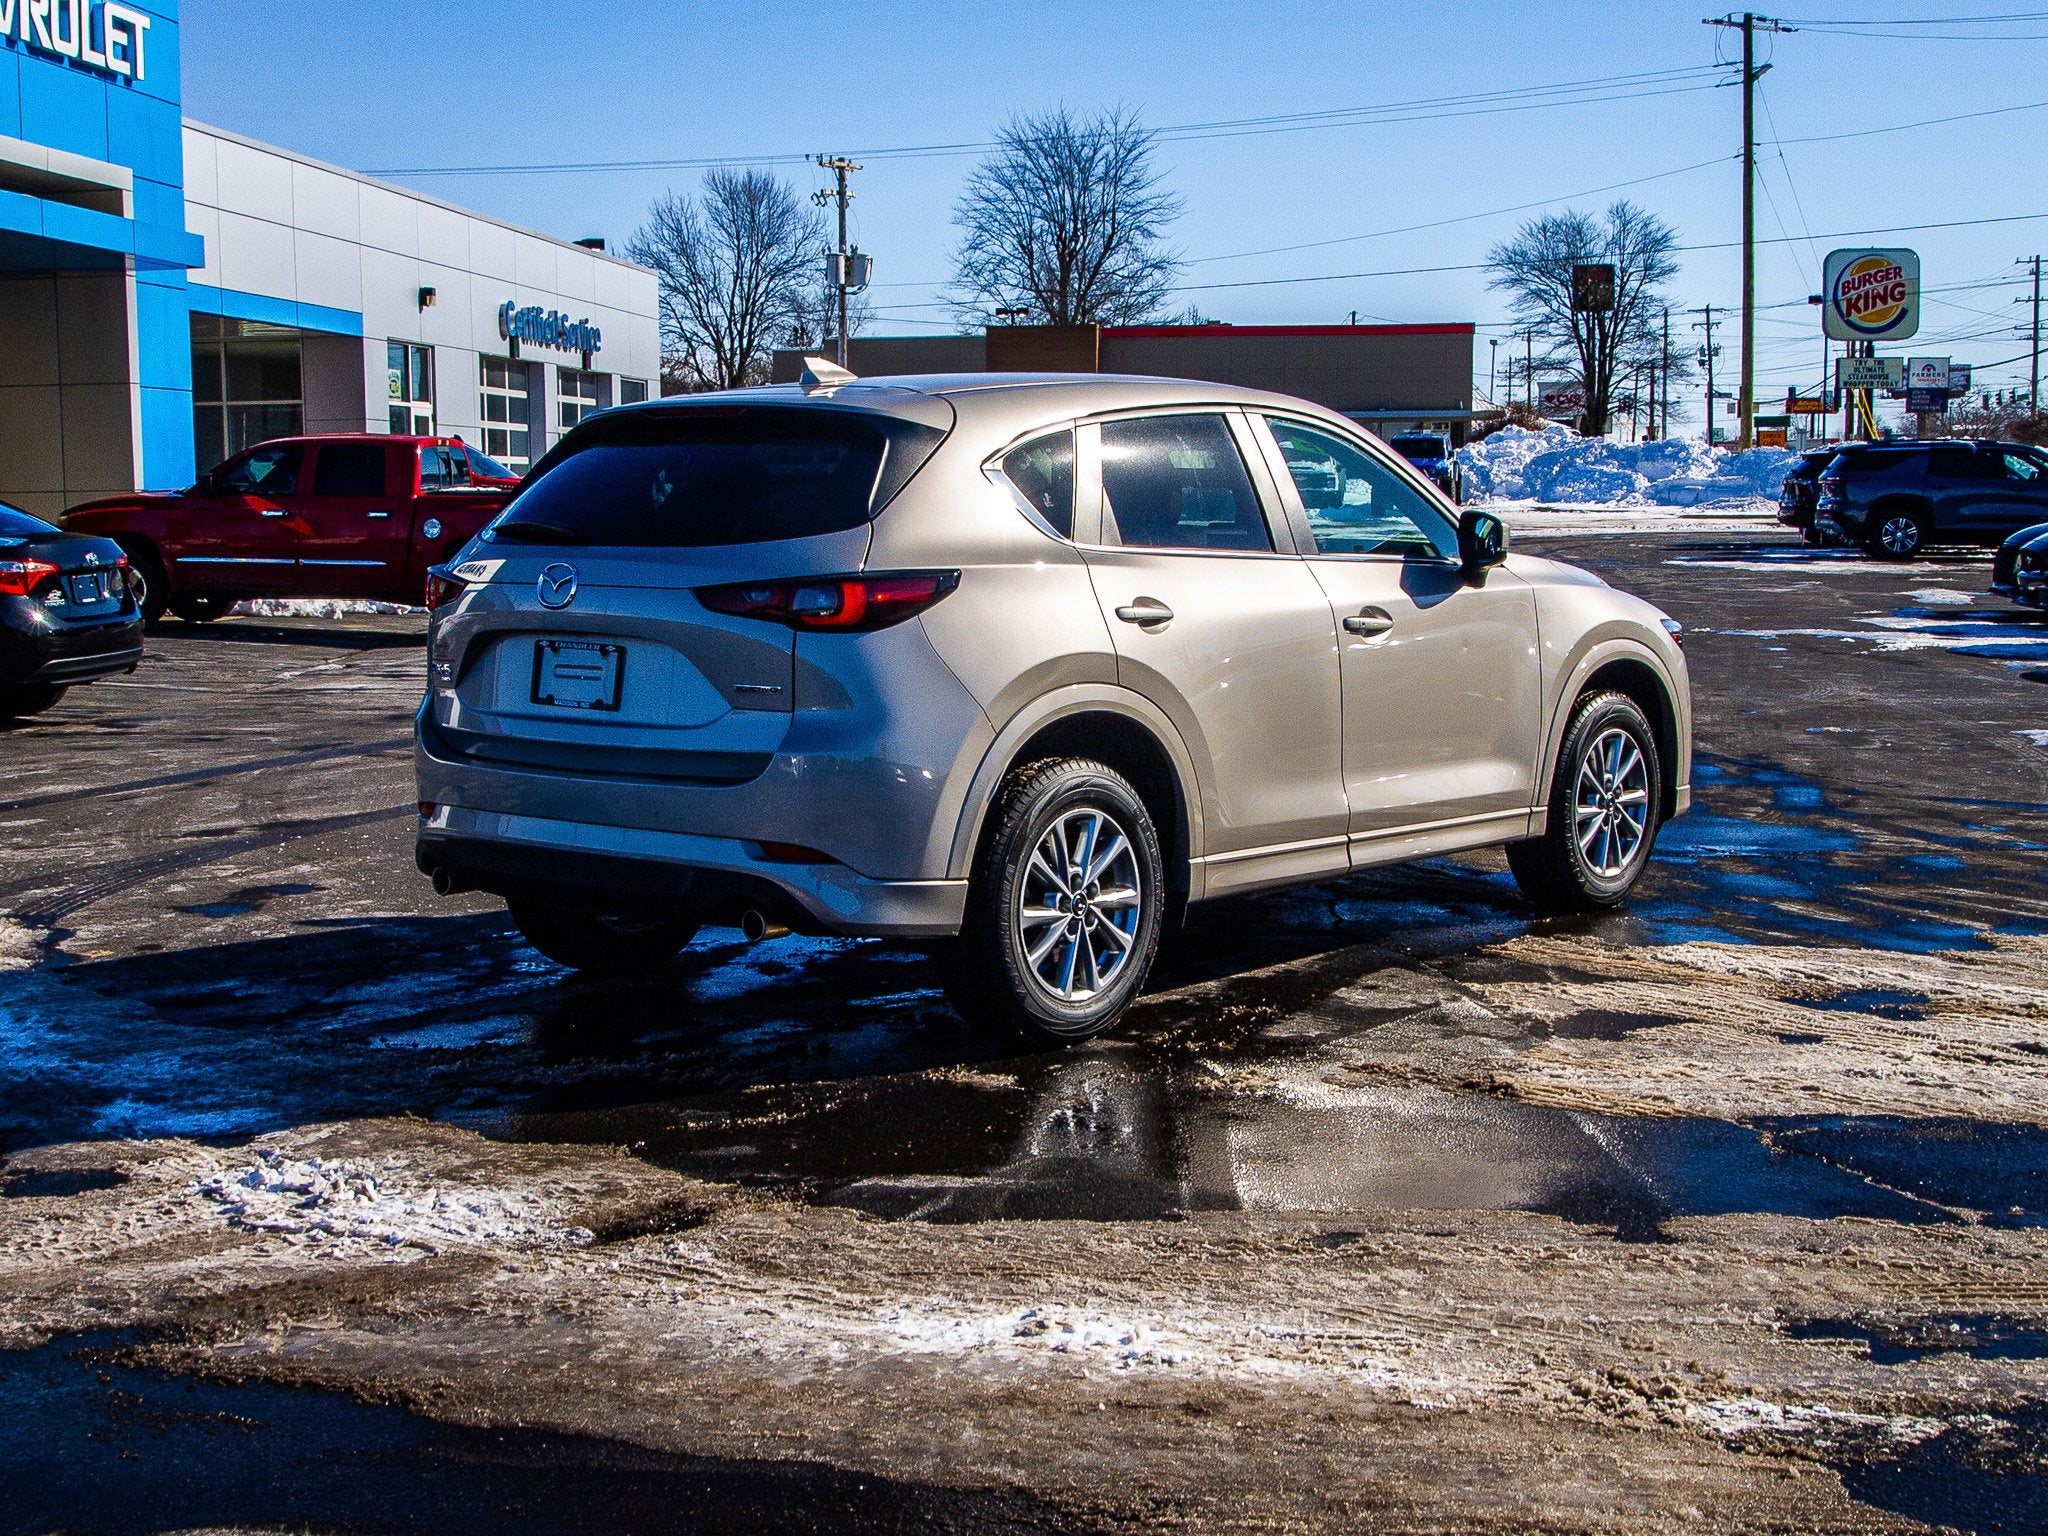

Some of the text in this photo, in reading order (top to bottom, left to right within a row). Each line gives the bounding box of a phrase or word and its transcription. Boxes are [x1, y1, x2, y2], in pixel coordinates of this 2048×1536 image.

[1841, 265, 1903, 297] BURGER
[1845, 282, 1906, 319] KING
[504, 300, 601, 352] Certified Service
